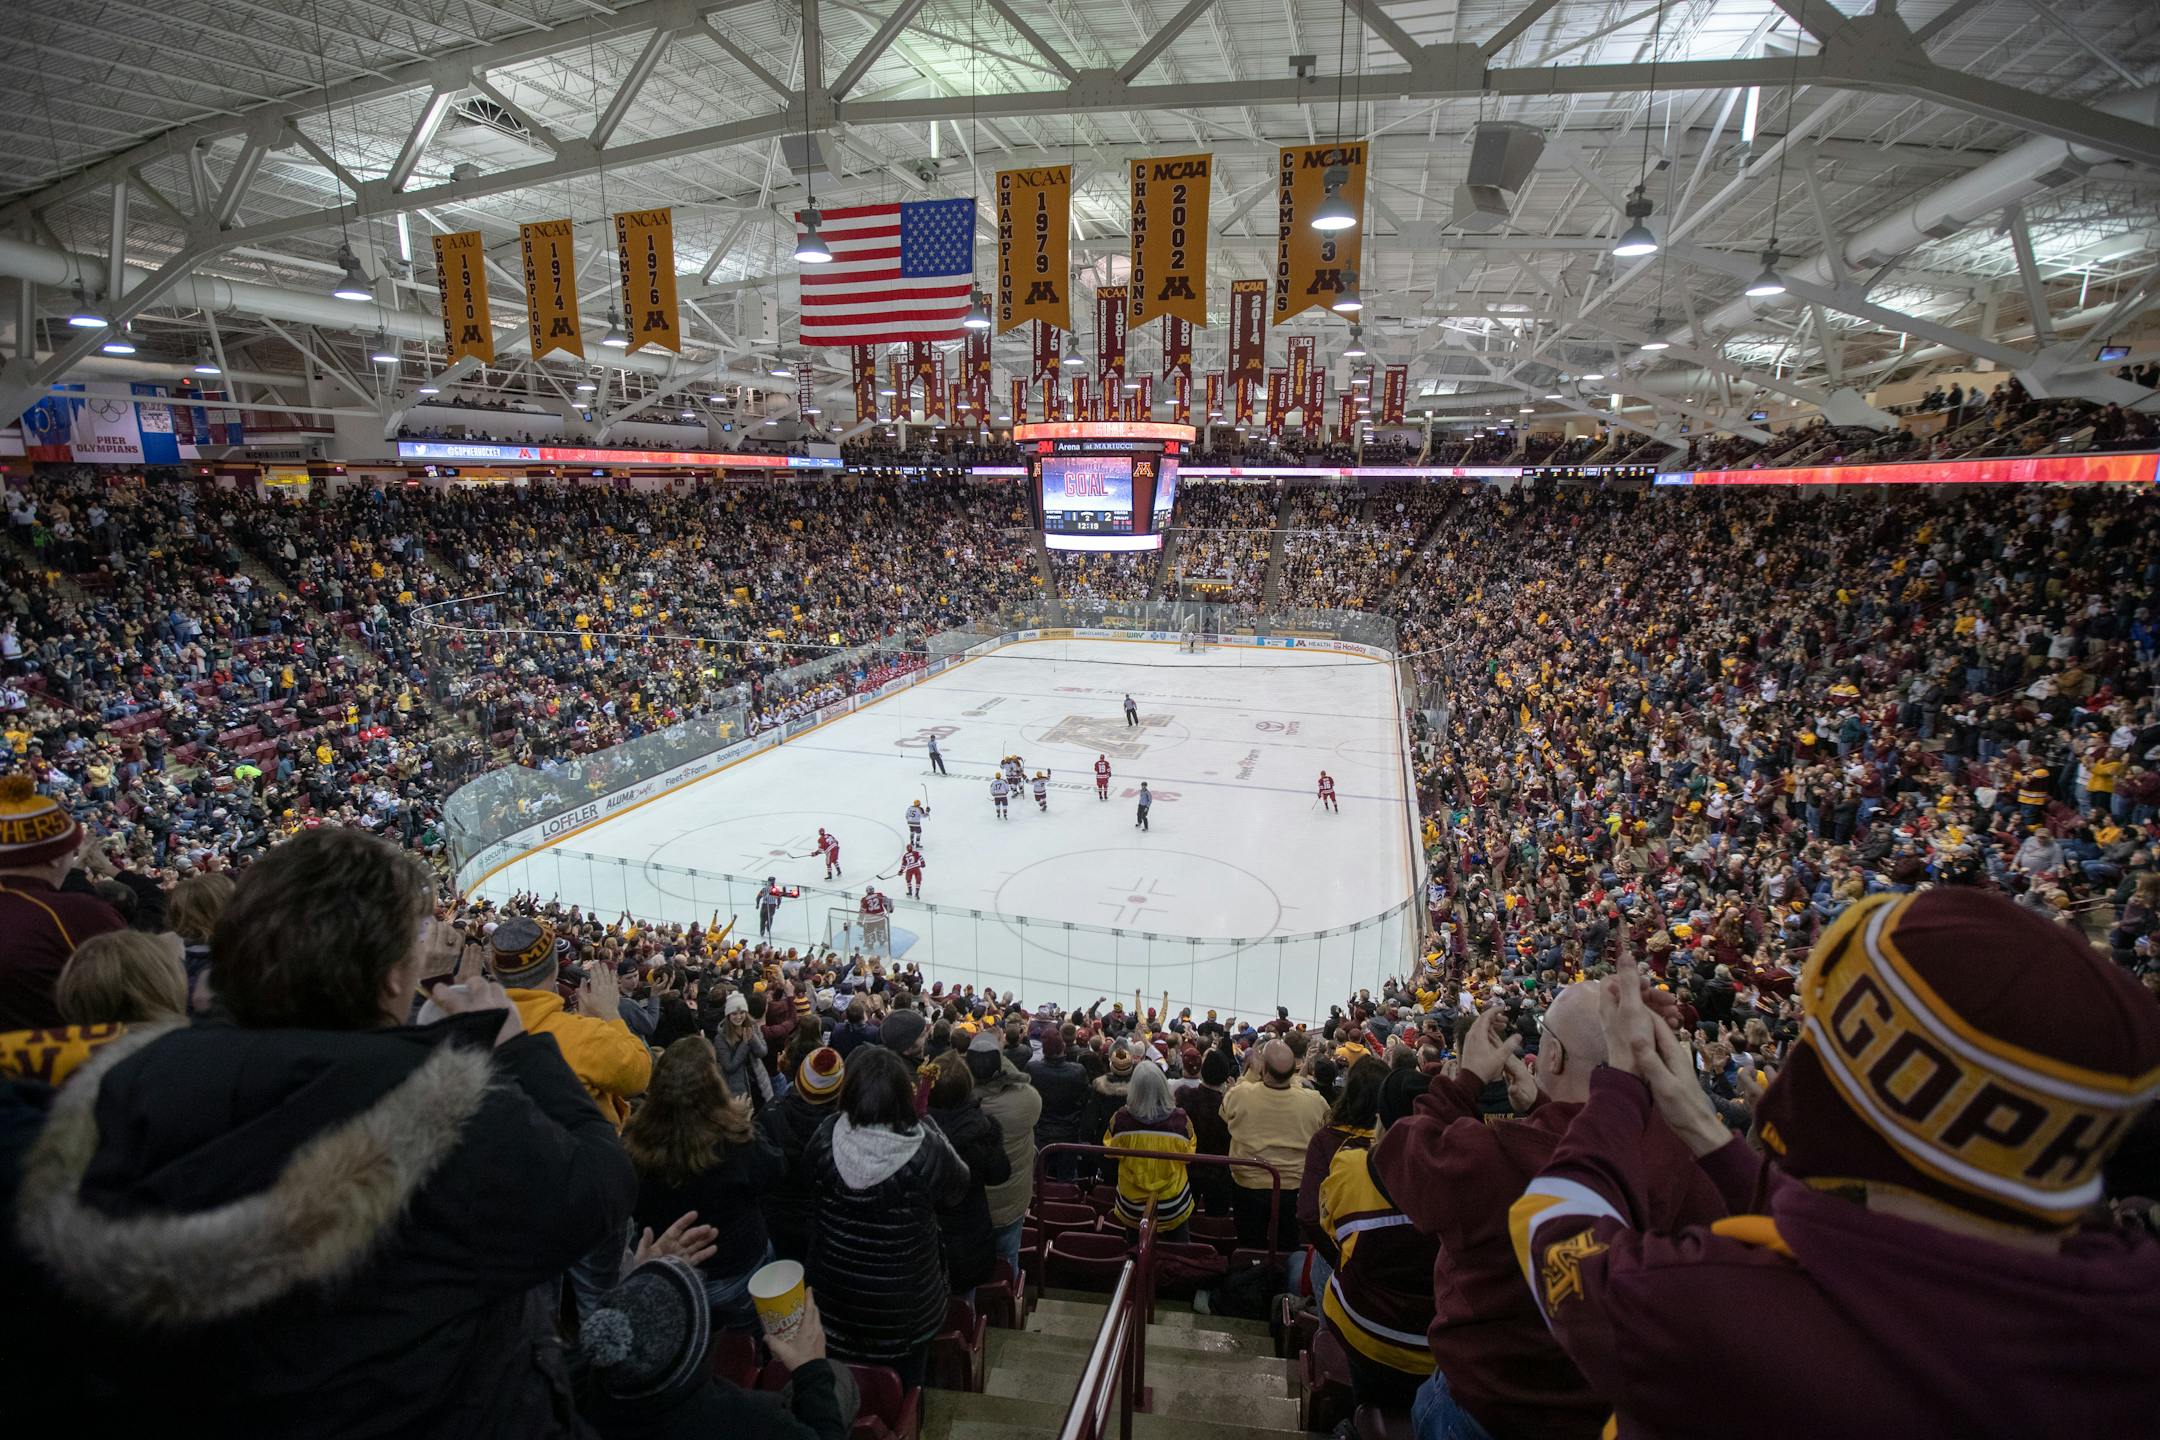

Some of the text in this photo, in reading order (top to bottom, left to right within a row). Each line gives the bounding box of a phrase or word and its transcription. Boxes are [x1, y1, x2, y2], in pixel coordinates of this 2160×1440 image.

[1016, 169, 1067, 188] NCAA
[1152, 160, 1207, 181] NCAA
[534, 224, 570, 239] NCAA
[629, 210, 670, 228] NCAA
[1171, 184, 1187, 270] 2002
[1277, 153, 1294, 311] CHAMPIONS
[448, 234, 476, 250] AAU
[1036, 192, 1049, 273] 1979
[1133, 165, 1147, 316] CHAMPIONS
[999, 175, 1013, 321] CHAMPIONS
[550, 242, 564, 311] 1974
[618, 216, 634, 344] CHAMPIONS
[647, 234, 659, 305] 1976
[435, 238, 454, 356] CHAMPIONS
[460, 254, 474, 320] 1940
[523, 227, 542, 349] CHAMPIONS
[1098, 288, 1127, 298] NCAA
[1233, 281, 1264, 292] NCAA
[1115, 300, 1124, 350] 1981
[1233, 294, 1242, 371] RUNNERS UP
[1250, 295, 1262, 345] 2014
[1050, 325, 1058, 351] 75
[1181, 321, 1190, 346] 89
[1100, 358, 1107, 374] UP
[1165, 356, 1171, 372] UP
[1296, 359, 1304, 395] 2015
[1279, 377, 1287, 408] 2006
[1395, 375, 1403, 405] 2013
[76, 444, 138, 455] OLYMPIANS
[96, 436, 125, 445] PHER
[1037, 441, 1054, 453] 3M
[1058, 442, 1080, 451] Arena
[1164, 442, 1179, 454] 3M
[1064, 471, 1109, 497] GOAL
[1104, 512, 1112, 521] 2
[1112, 631, 1145, 639] SUBWAY
[1342, 642, 1366, 654] Holiday
[717, 743, 753, 762] Booking.com
[665, 764, 708, 787] Fleet Farm
[2, 811, 65, 843] HERS
[542, 804, 599, 838] LOFFLER
[868, 898, 880, 911] 32
